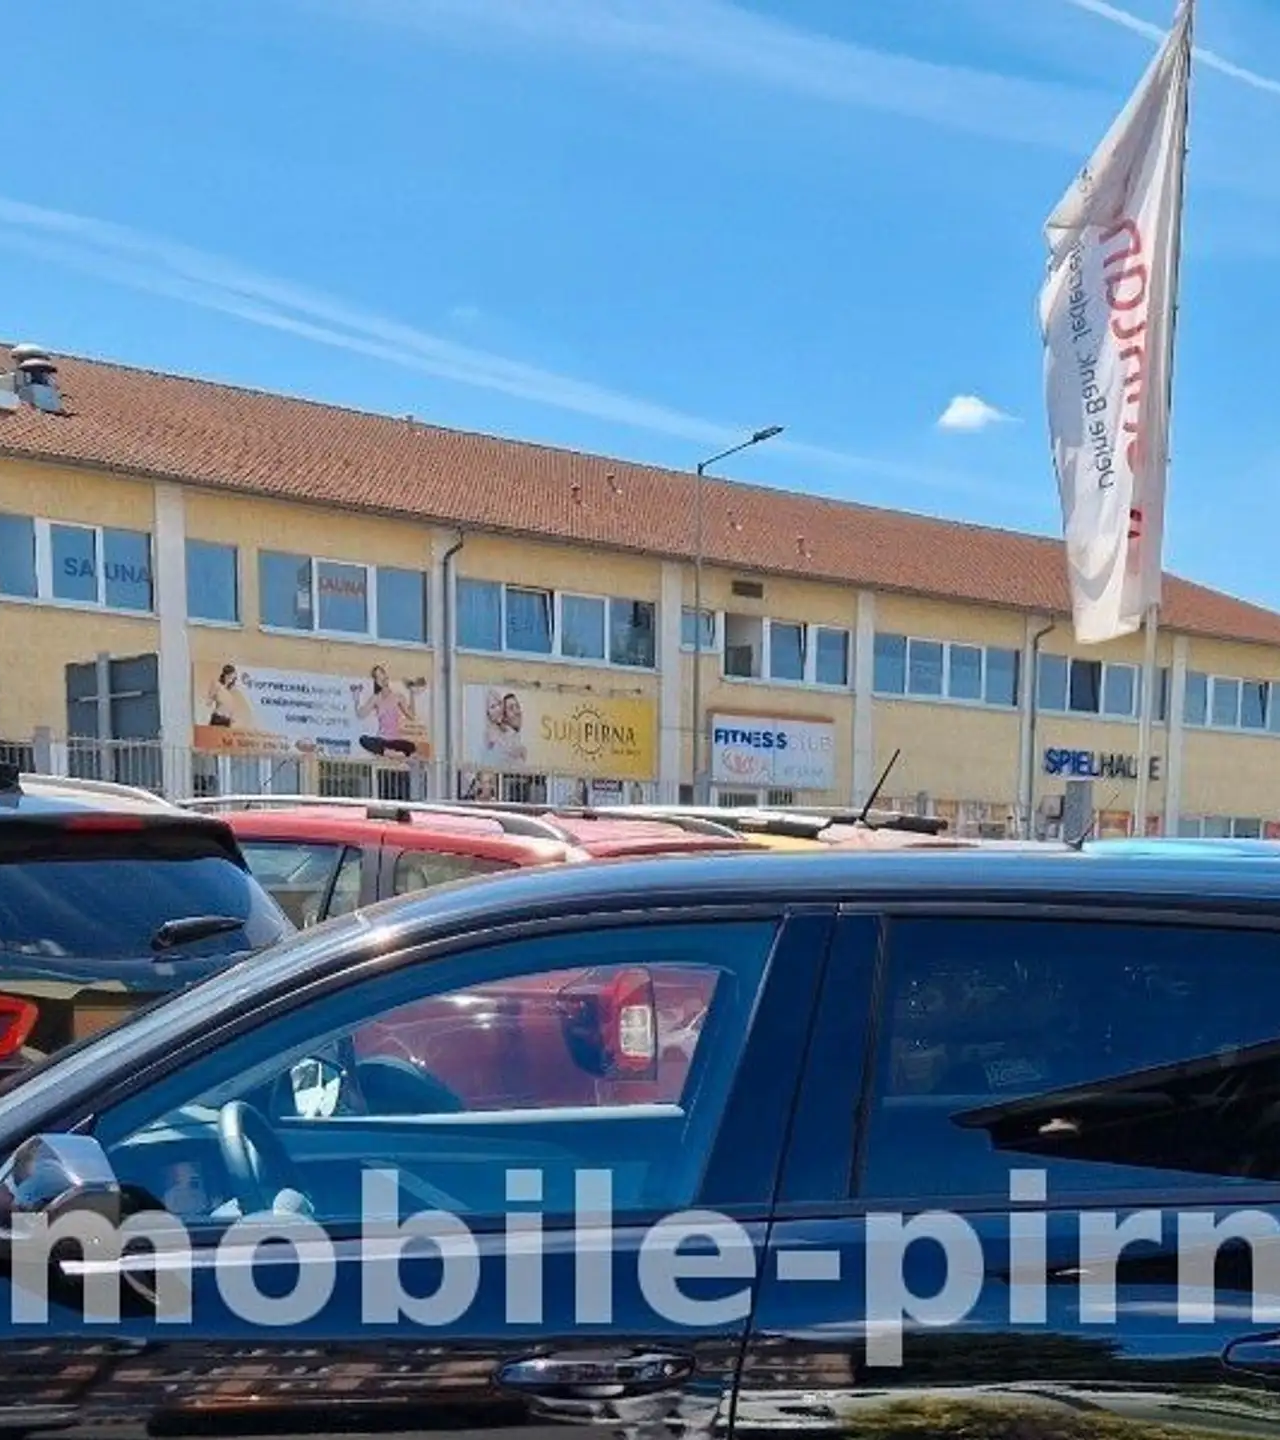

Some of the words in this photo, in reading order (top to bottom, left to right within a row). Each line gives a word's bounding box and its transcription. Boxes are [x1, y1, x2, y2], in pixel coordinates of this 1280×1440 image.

[63, 557, 152, 584] SAUNA
[714, 728, 788, 750] FITNESS
[1045, 748, 1161, 781] SPIELHALE
